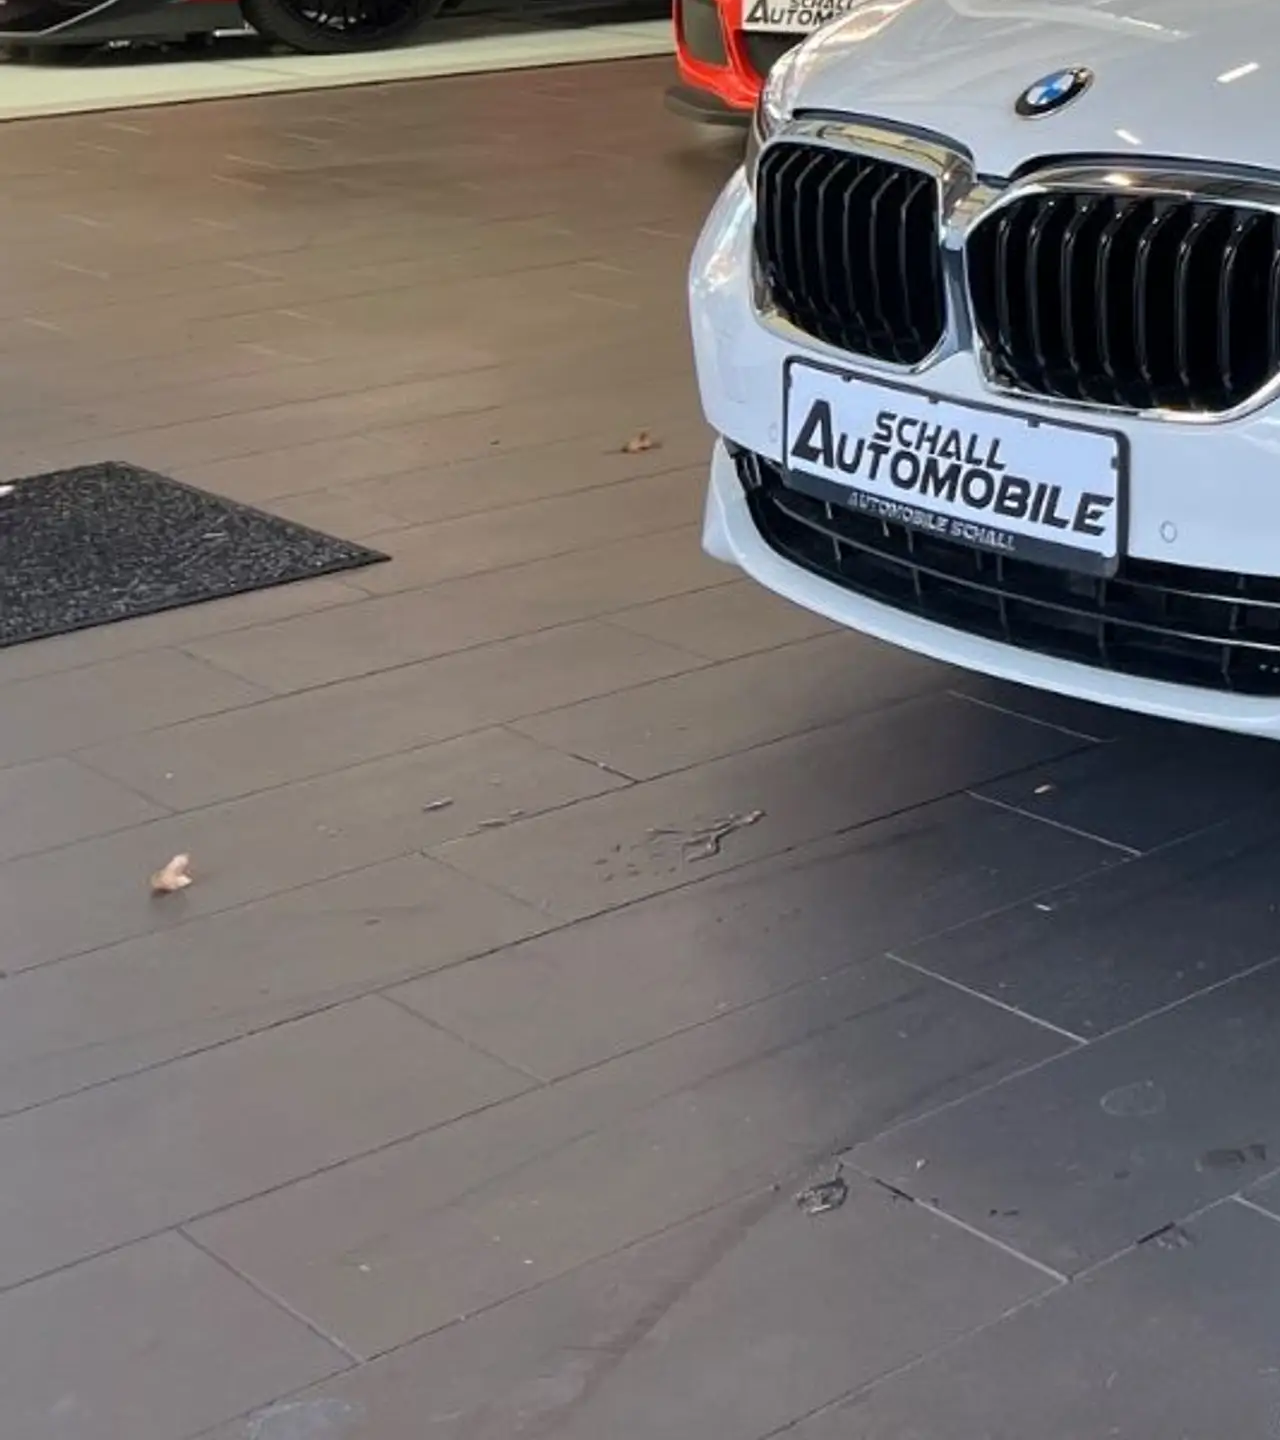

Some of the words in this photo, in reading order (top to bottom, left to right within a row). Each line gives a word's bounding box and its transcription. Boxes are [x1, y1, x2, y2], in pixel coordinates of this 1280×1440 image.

[790, 398, 1115, 537] AUTOMOBILE
[872, 410, 1007, 471] SCHALL
[848, 491, 949, 533] AUTOMOBILE
[950, 519, 1017, 551] SCHALL
